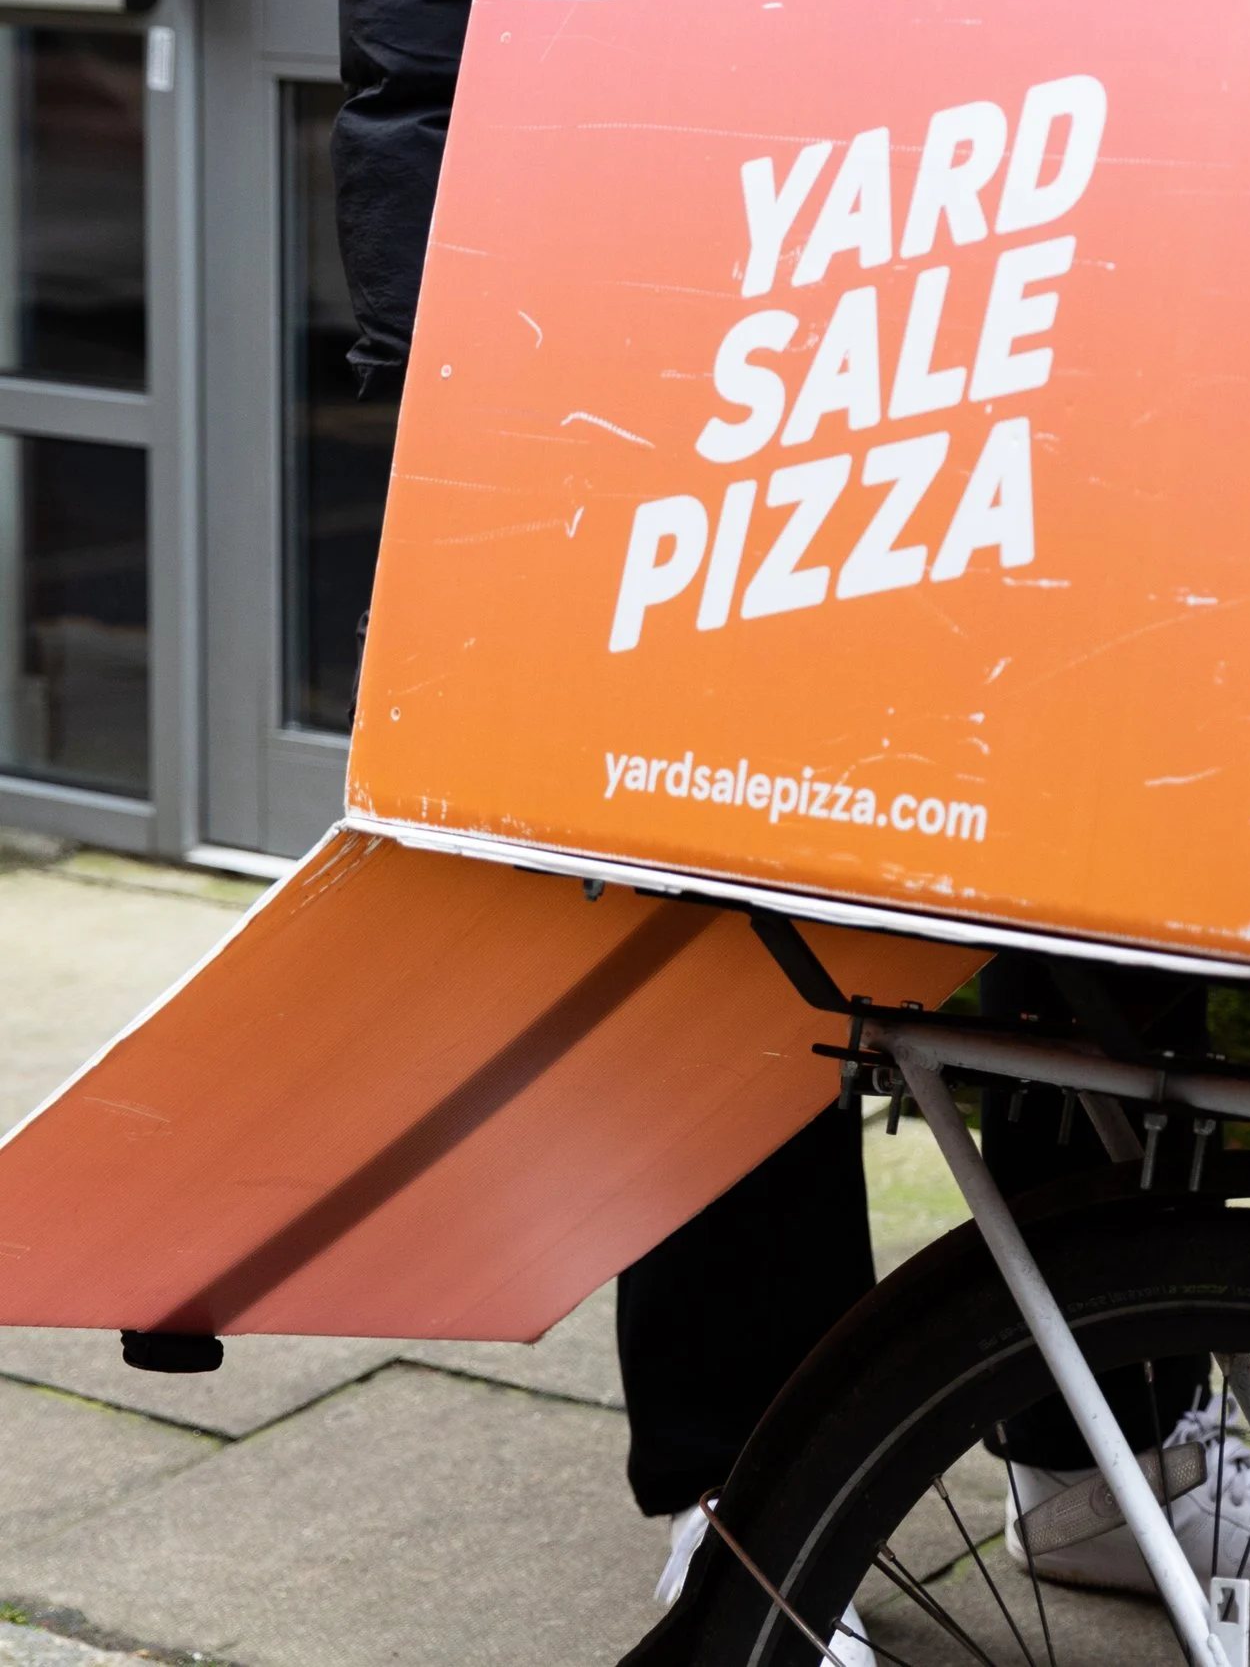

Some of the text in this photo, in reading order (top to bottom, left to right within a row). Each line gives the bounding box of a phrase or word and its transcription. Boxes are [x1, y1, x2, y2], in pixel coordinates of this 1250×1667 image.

[740, 74, 1108, 298] YARD
[695, 235, 1077, 464] SALE
[608, 417, 1036, 653] PIZZA
[604, 751, 988, 842] yardsalepizza.com
